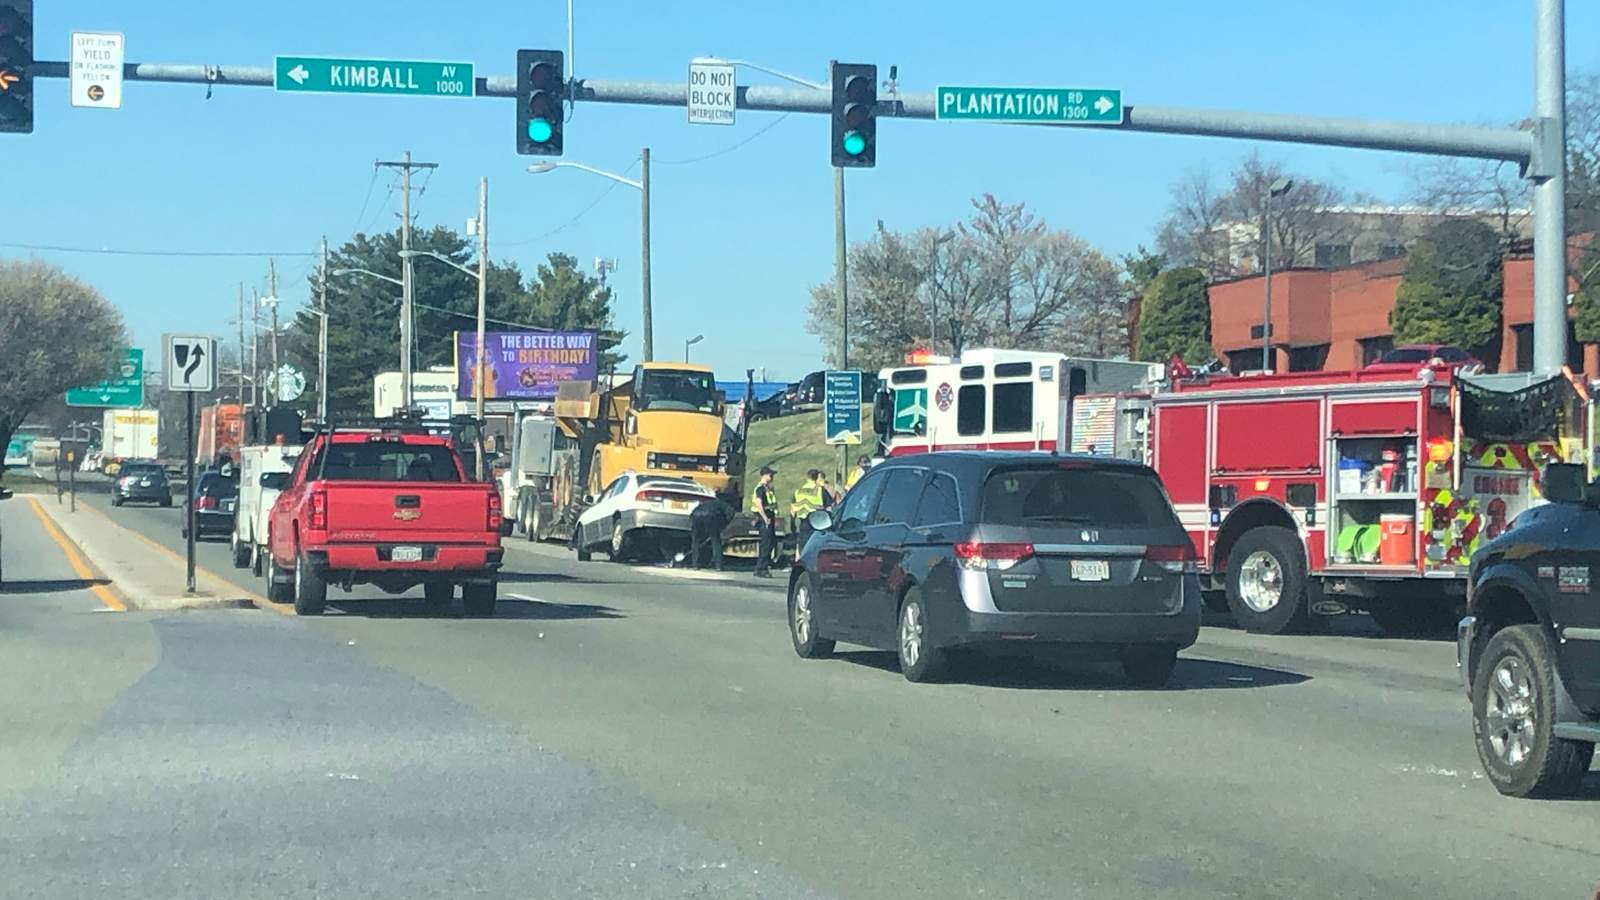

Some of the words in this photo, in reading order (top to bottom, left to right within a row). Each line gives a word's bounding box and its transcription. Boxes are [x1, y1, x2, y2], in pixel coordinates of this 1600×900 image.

[83, 49, 111, 60] YIELD
[330, 65, 419, 89] KIMBALL
[441, 66, 457, 78] AV
[691, 71, 706, 85] DO
[710, 72, 732, 87] NOT
[436, 80, 464, 94] 1000
[692, 91, 732, 106] BLOCK
[943, 92, 1059, 116] PLANTATION
[1067, 91, 1083, 105] RD
[1062, 106, 1089, 119] 1300
[501, 335, 521, 349] THE
[523, 335, 565, 349] BETTER
[567, 335, 592, 350] WAY
[503, 351, 515, 363] TO
[518, 349, 590, 364] BIRTHDAY!
